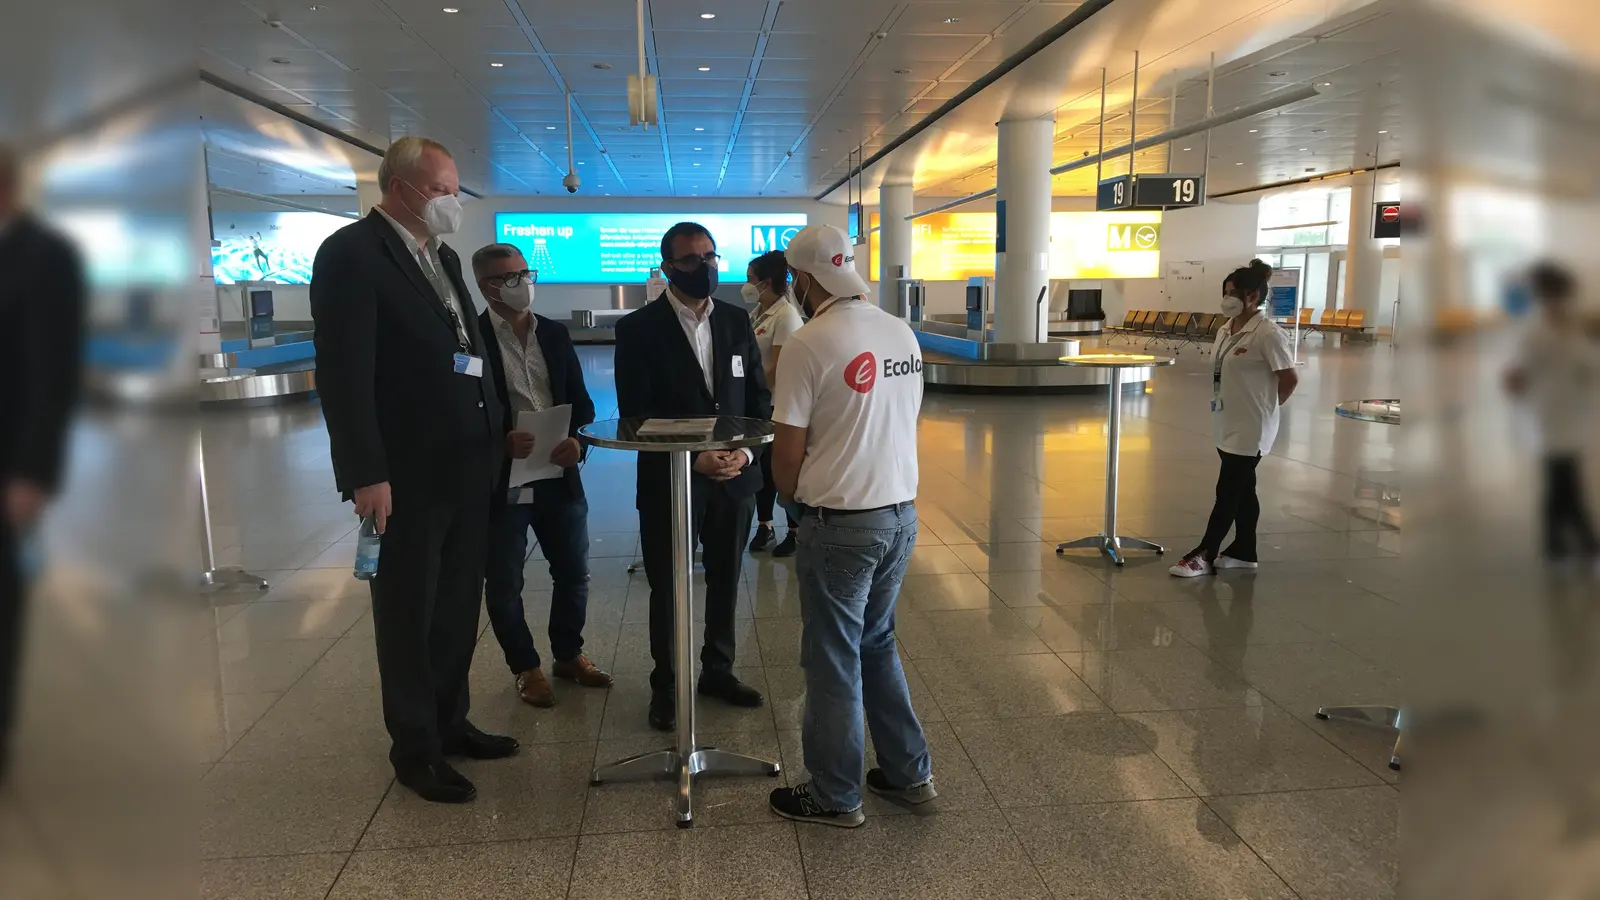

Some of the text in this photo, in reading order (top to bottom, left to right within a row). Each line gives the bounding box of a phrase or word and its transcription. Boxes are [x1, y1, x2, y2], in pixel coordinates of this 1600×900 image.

[1113, 182, 1124, 204] 19
[1172, 179, 1195, 202] 19
[503, 223, 573, 239] Freshen up
[753, 227, 776, 251] M
[1109, 226, 1131, 248] M
